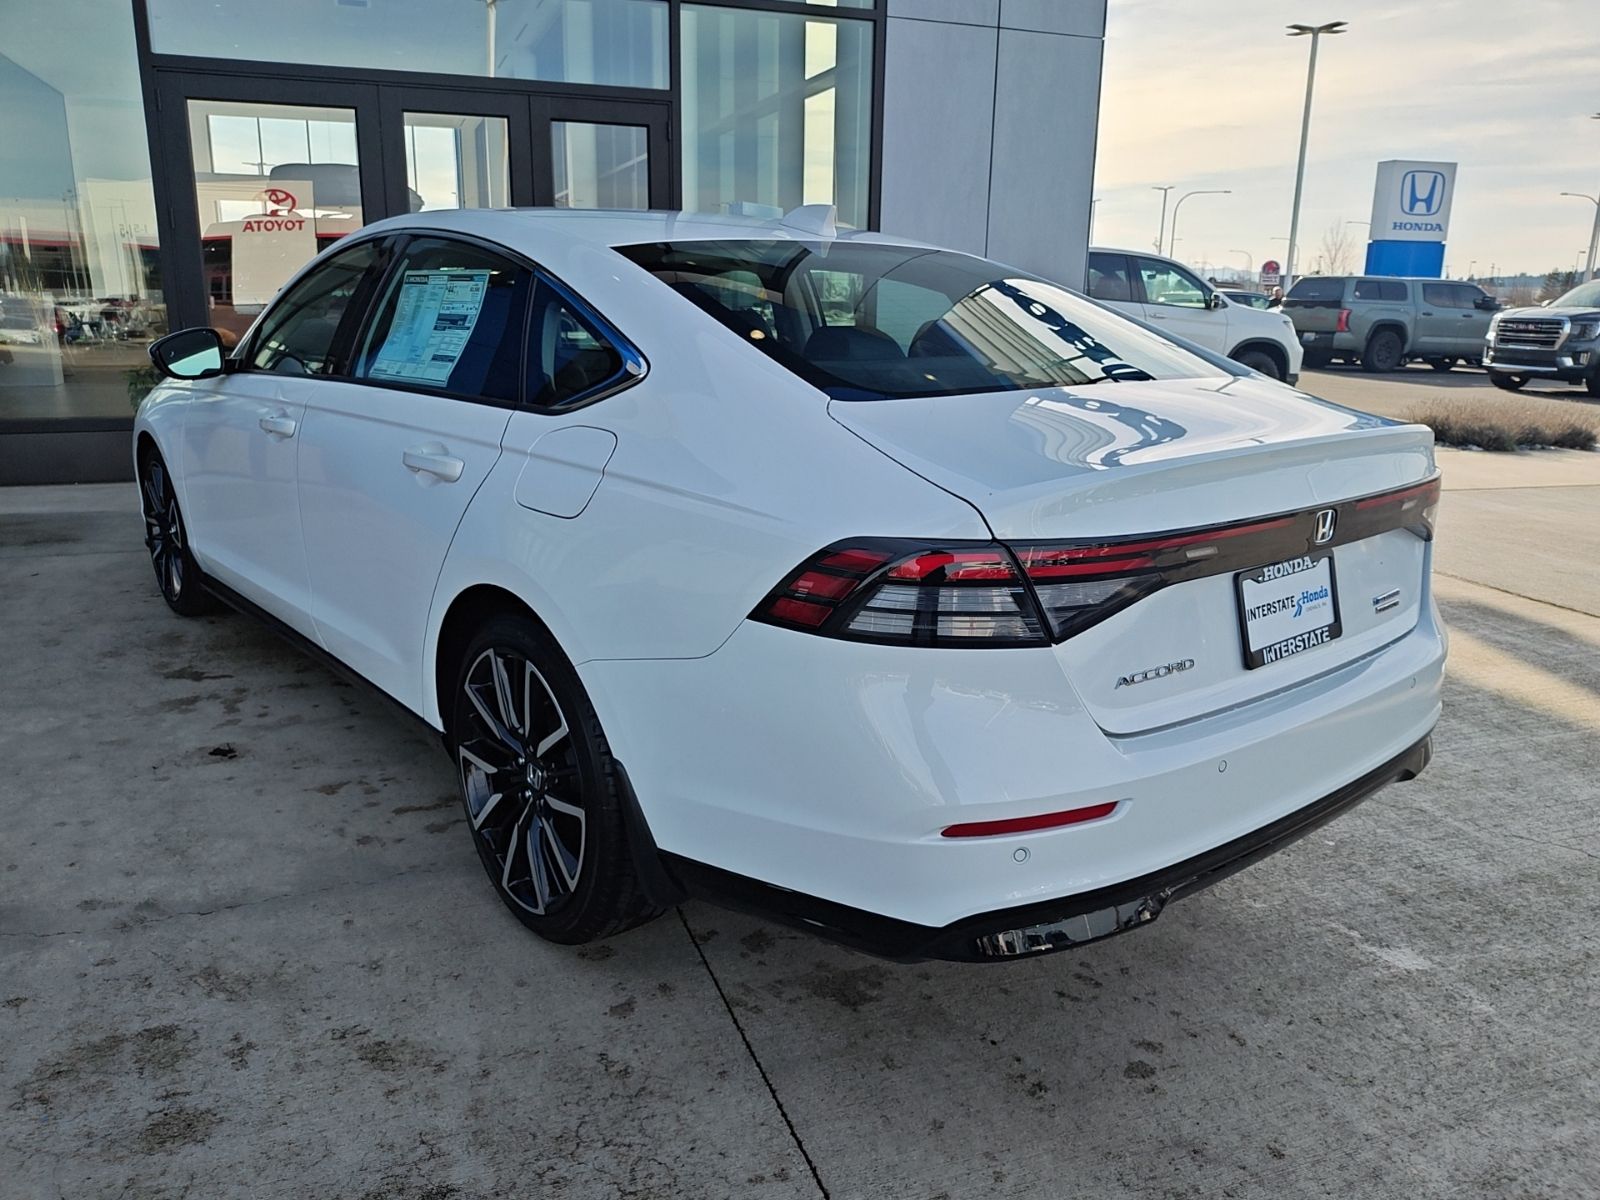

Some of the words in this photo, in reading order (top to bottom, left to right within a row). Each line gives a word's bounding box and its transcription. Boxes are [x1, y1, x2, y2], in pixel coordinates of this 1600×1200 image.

[1392, 221, 1444, 232] HONDA
[1263, 556, 1313, 581] HONDA
[1247, 595, 1296, 622] INTERSTATE
[1302, 585, 1329, 605] Honda
[1263, 626, 1331, 664] INTERSTATE
[1114, 658, 1195, 690] ACCORD
